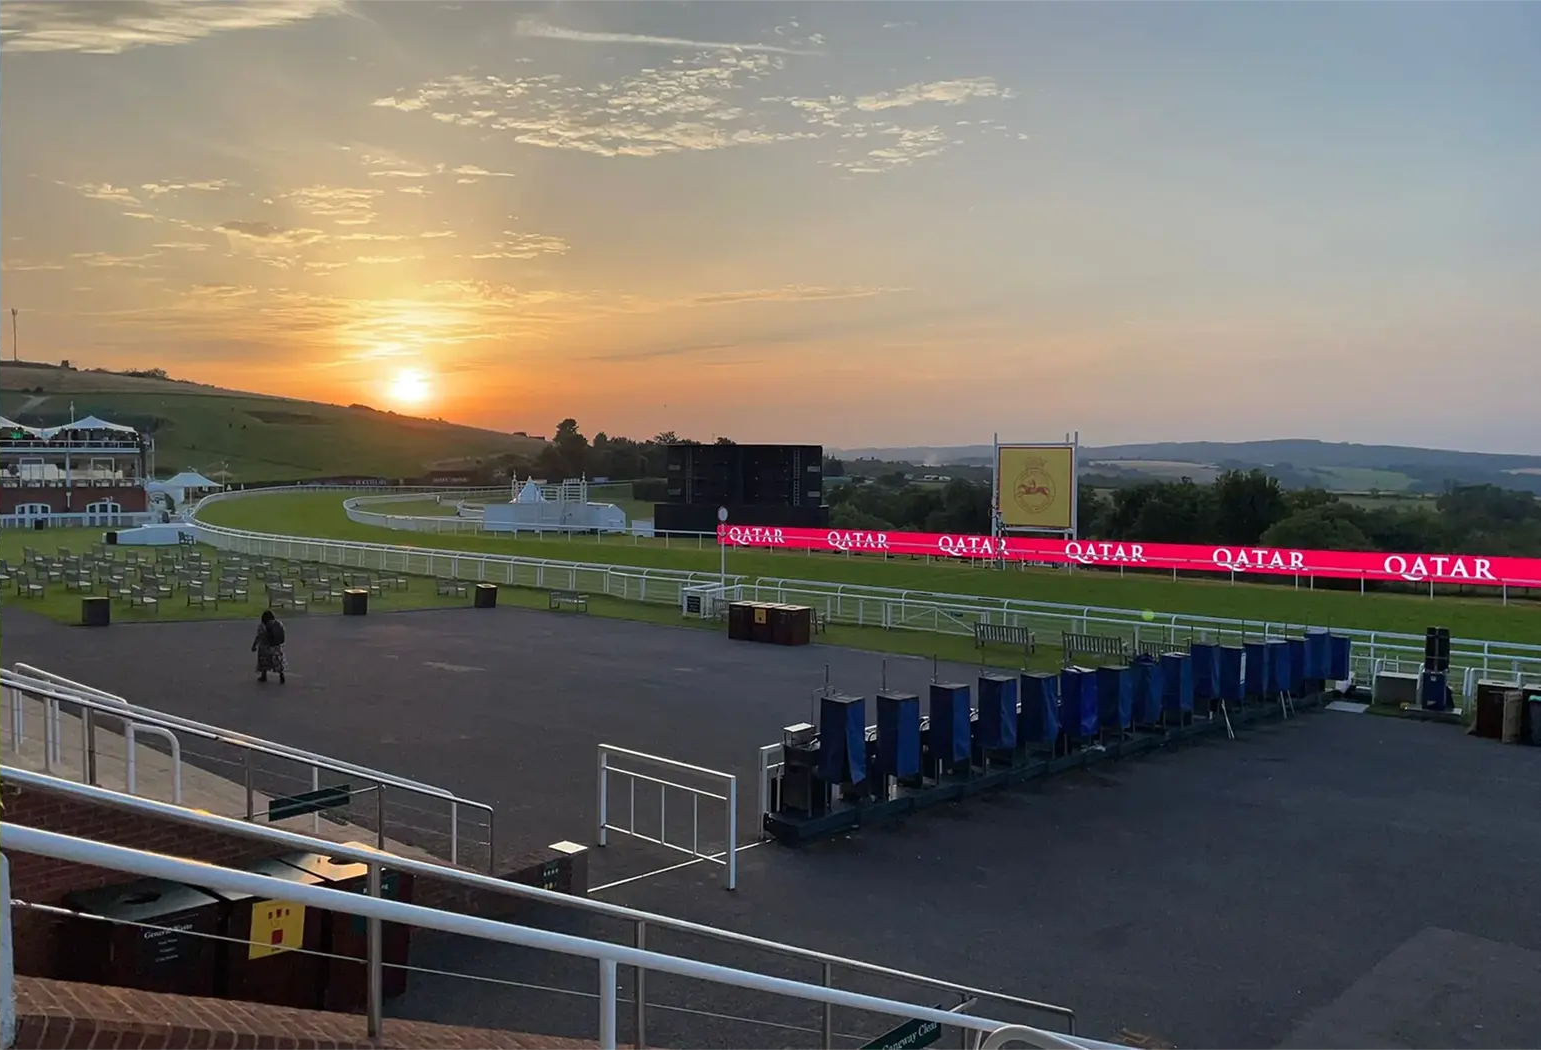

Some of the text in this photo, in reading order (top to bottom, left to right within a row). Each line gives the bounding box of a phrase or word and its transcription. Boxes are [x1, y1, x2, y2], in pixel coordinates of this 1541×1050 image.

[729, 527, 1497, 581] QATAR QATAR QATAR QATAR QATAR QATAR
